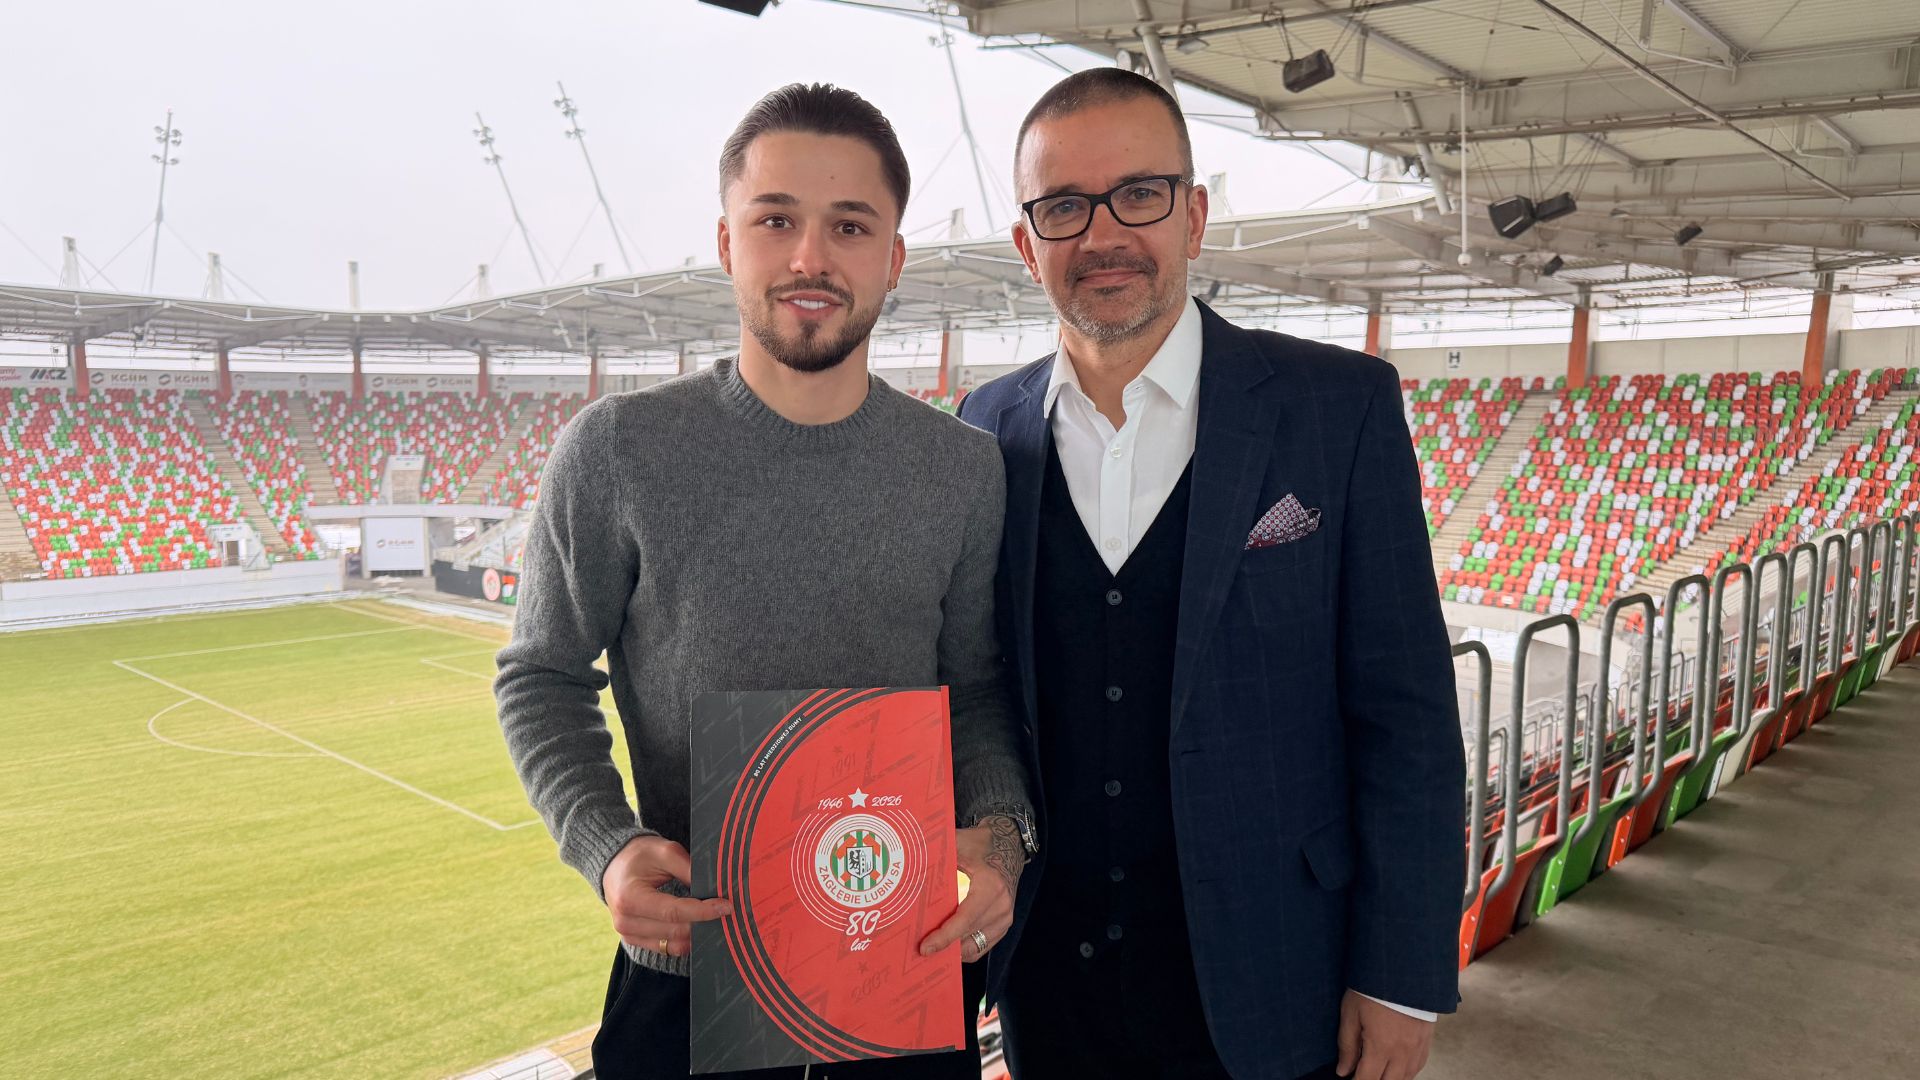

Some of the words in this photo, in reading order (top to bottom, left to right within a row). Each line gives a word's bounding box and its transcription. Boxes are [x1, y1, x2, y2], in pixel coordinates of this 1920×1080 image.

[1449, 351, 1460, 363] H
[111, 374, 148, 382] KGHM
[174, 375, 209, 383] KGHM
[757, 759, 767, 770] LAT
[817, 797, 844, 810] 1946
[871, 794, 903, 807] 2026
[864, 879, 894, 903] LUBIN
[890, 861, 901, 878] SA
[845, 909, 881, 936] 80
[850, 937, 872, 952] lat
